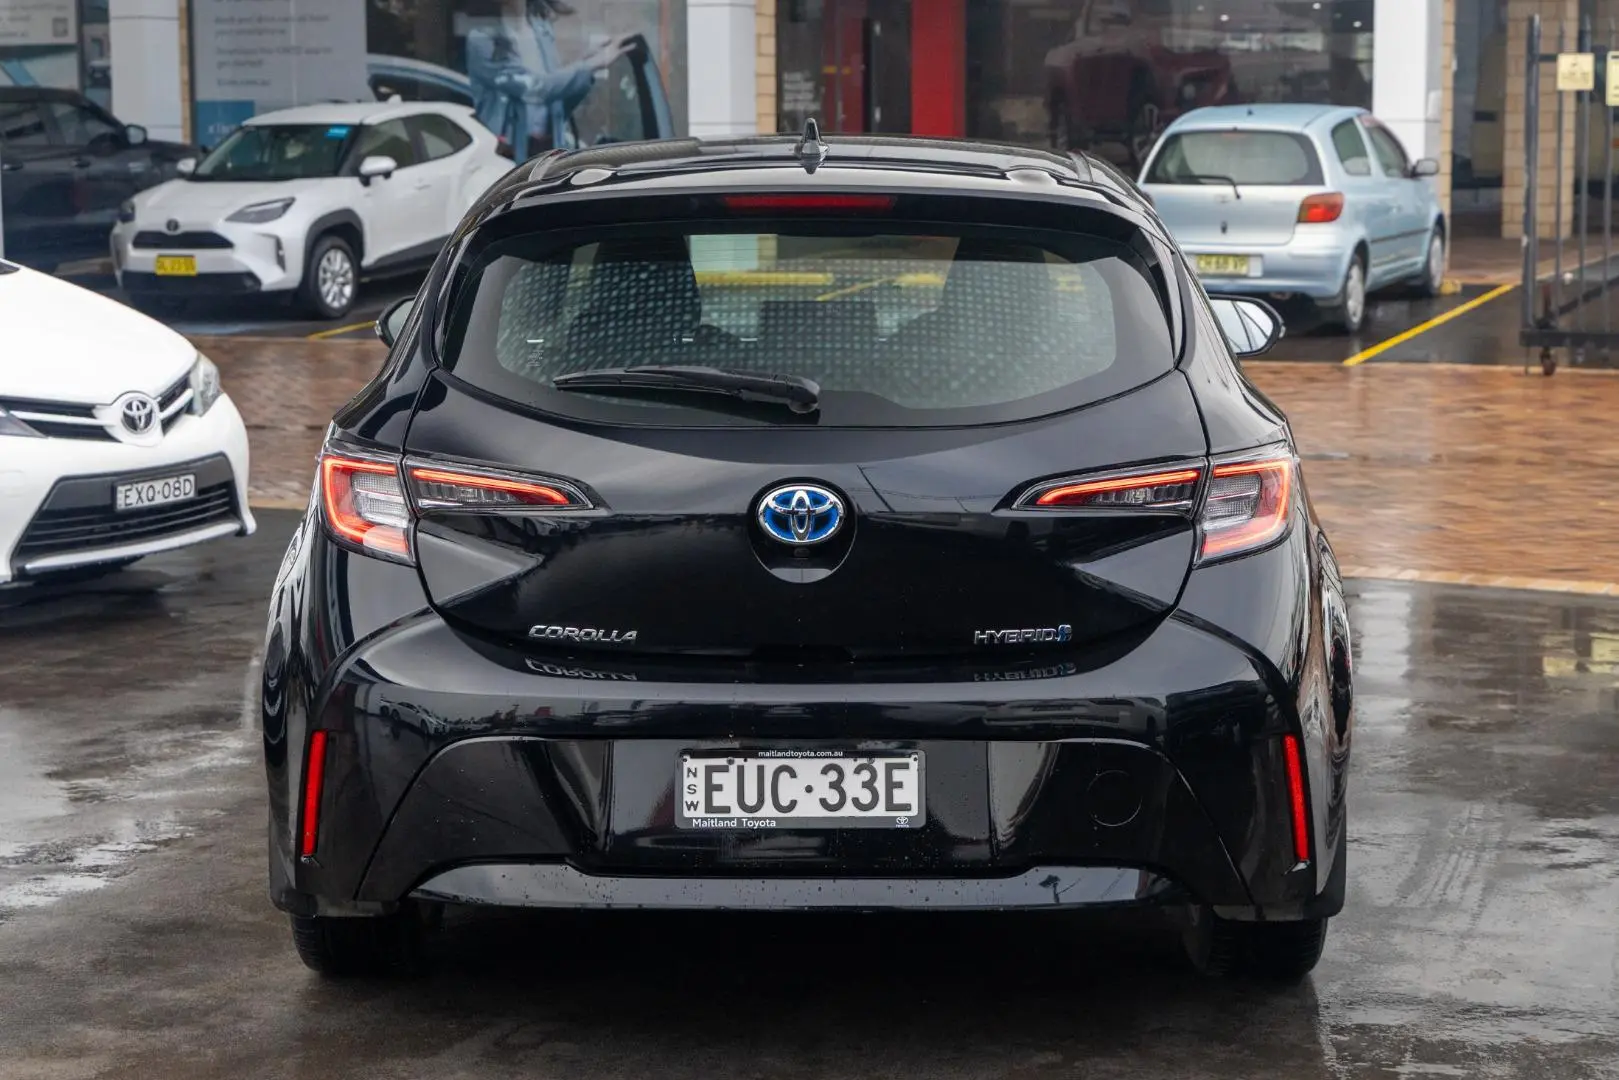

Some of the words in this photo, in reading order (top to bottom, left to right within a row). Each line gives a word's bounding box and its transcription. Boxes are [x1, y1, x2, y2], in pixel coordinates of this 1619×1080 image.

[528, 624, 638, 642] COROLLA
[974, 628, 1057, 644] HYBRID
[758, 750, 843, 758] maitlandtoyota.com.au
[685, 767, 699, 811] NSW
[692, 818, 737, 828] Maitland
[741, 818, 776, 829] Toyota
